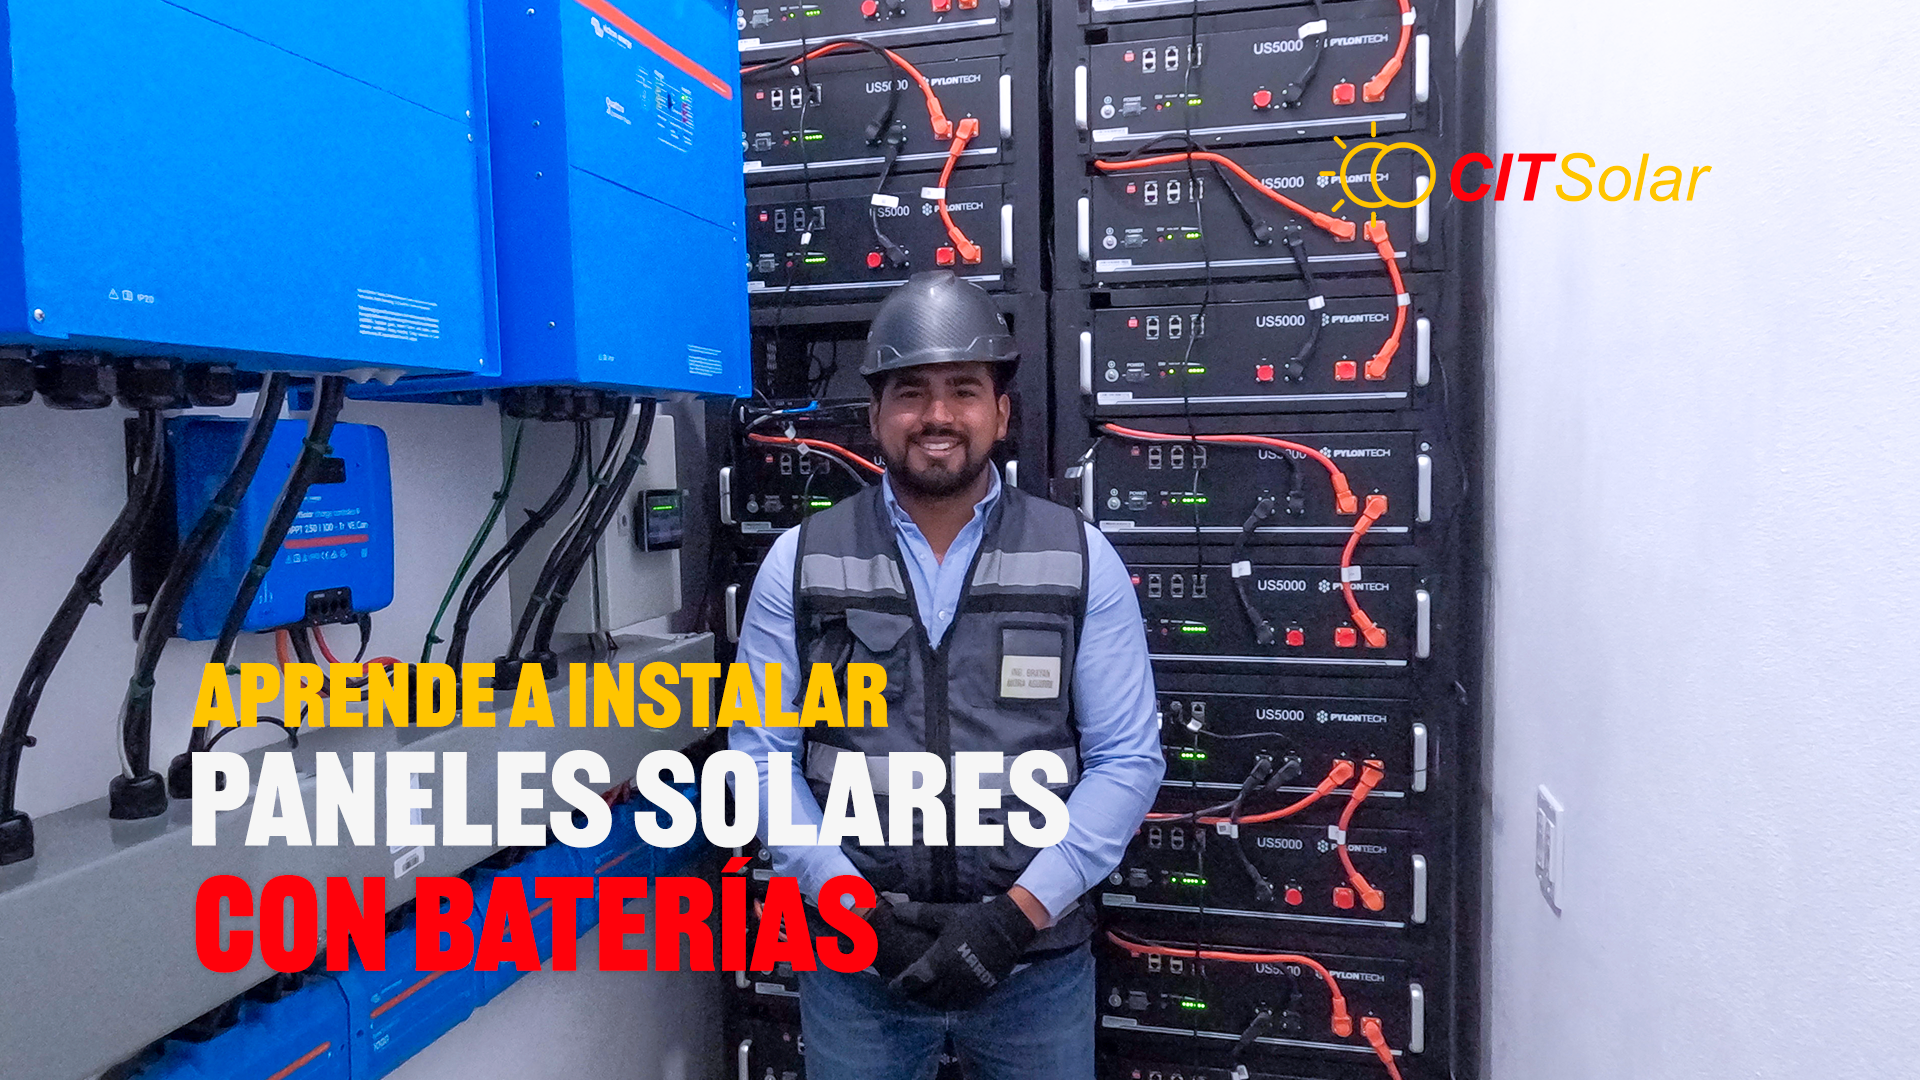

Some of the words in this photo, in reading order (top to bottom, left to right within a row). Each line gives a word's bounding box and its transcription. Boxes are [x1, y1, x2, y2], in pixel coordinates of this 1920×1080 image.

[1329, 33, 1389, 47] PYLONTECH
[1253, 39, 1303, 55] US5000
[931, 74, 981, 86] PYLONTECH
[869, 205, 910, 218] S5000
[934, 201, 983, 213] PLONTECH
[1256, 314, 1306, 328] US5000
[1331, 313, 1390, 324] PYLONTECH
[1333, 448, 1391, 458] PYLONTECH
[1257, 579, 1307, 592] US5000
[1332, 581, 1390, 592] PYONTECH
[1256, 708, 1305, 722] US5000
[1330, 712, 1388, 724] PYLONTECH
[1256, 837, 1303, 851] US5000
[1330, 842, 1388, 854] PONTECH
[1255, 962, 1301, 977] US500
[1330, 970, 1386, 983] PYLONTECH
